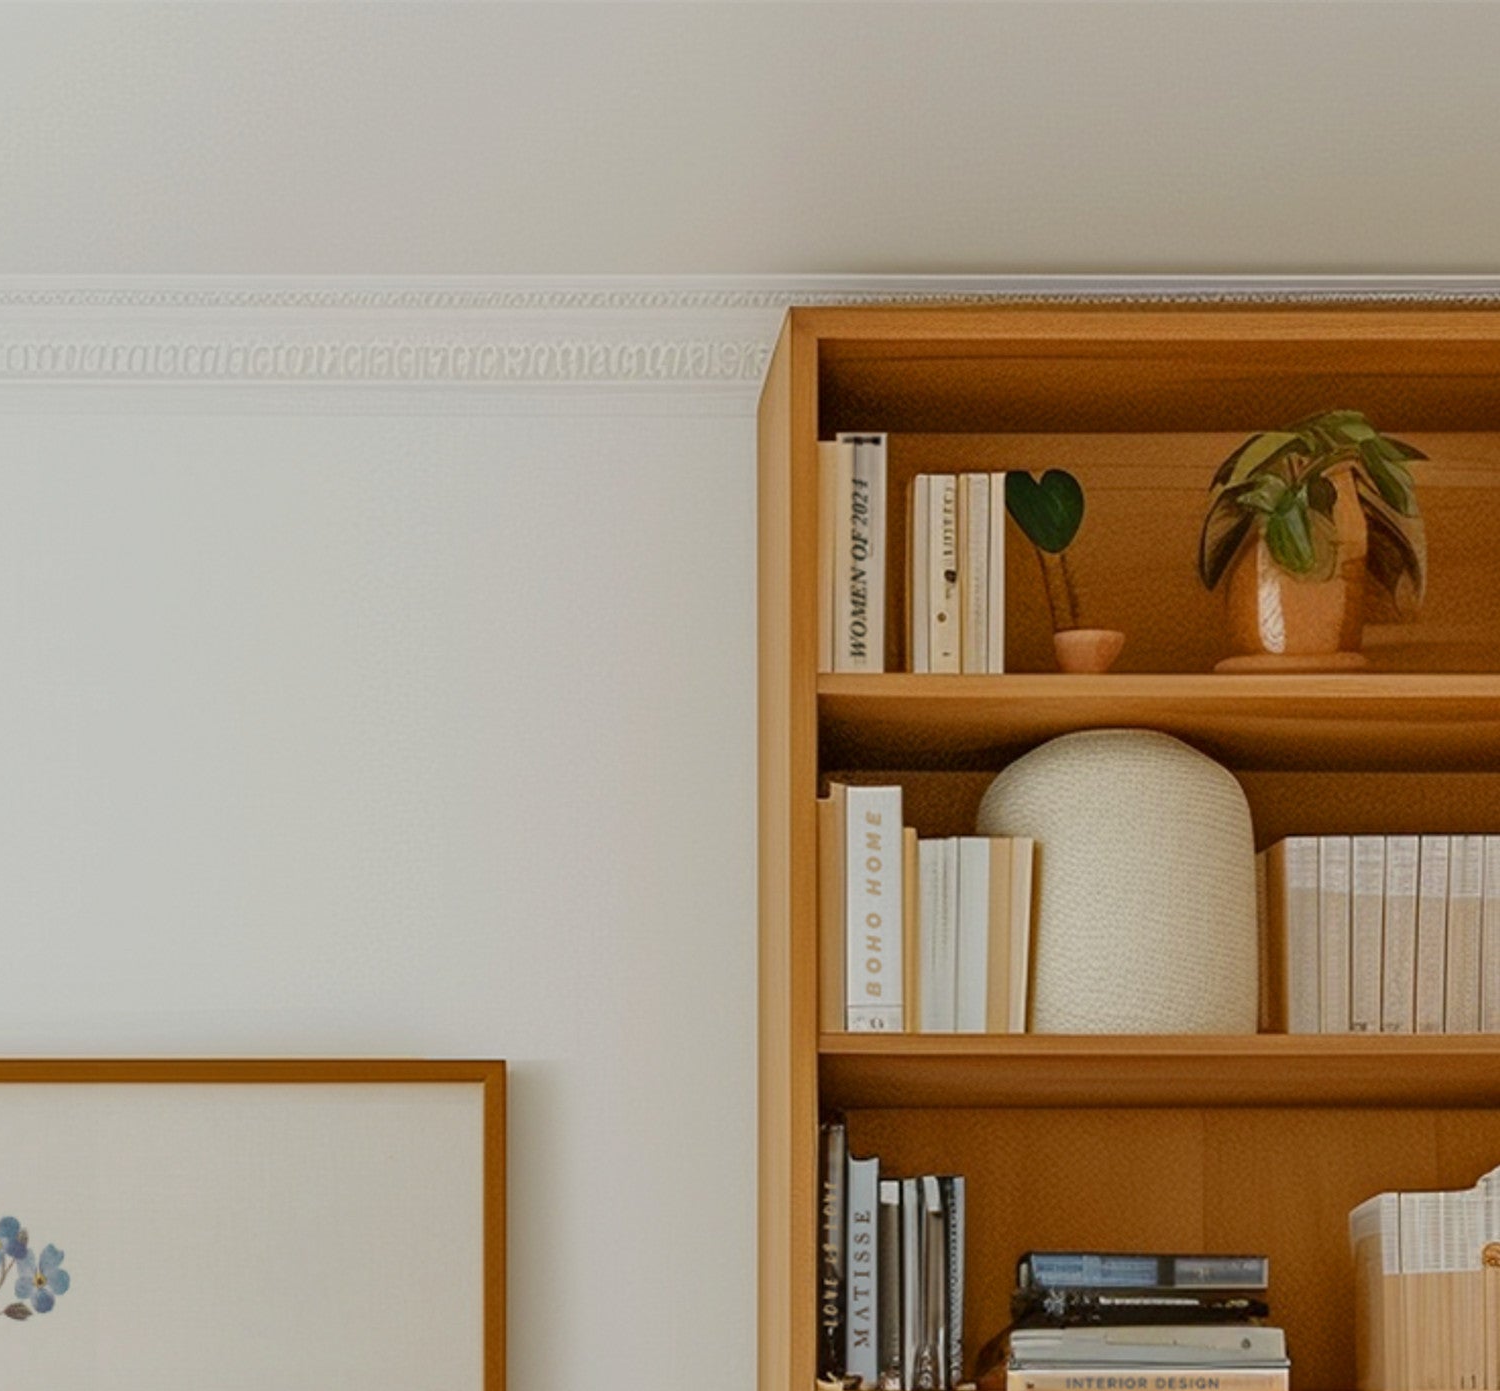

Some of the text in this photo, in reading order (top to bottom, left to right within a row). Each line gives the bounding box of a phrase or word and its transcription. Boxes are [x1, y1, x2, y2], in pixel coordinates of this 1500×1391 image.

[850, 478, 869, 658] WOMEN OF 2024
[865, 811, 882, 896] HOME
[865, 912, 882, 998] BOHO
[823, 1278, 839, 1327] LOVE
[853, 1210, 871, 1348] MATISSE
[1065, 1376, 1220, 1390] INTERIOR DESIGN
